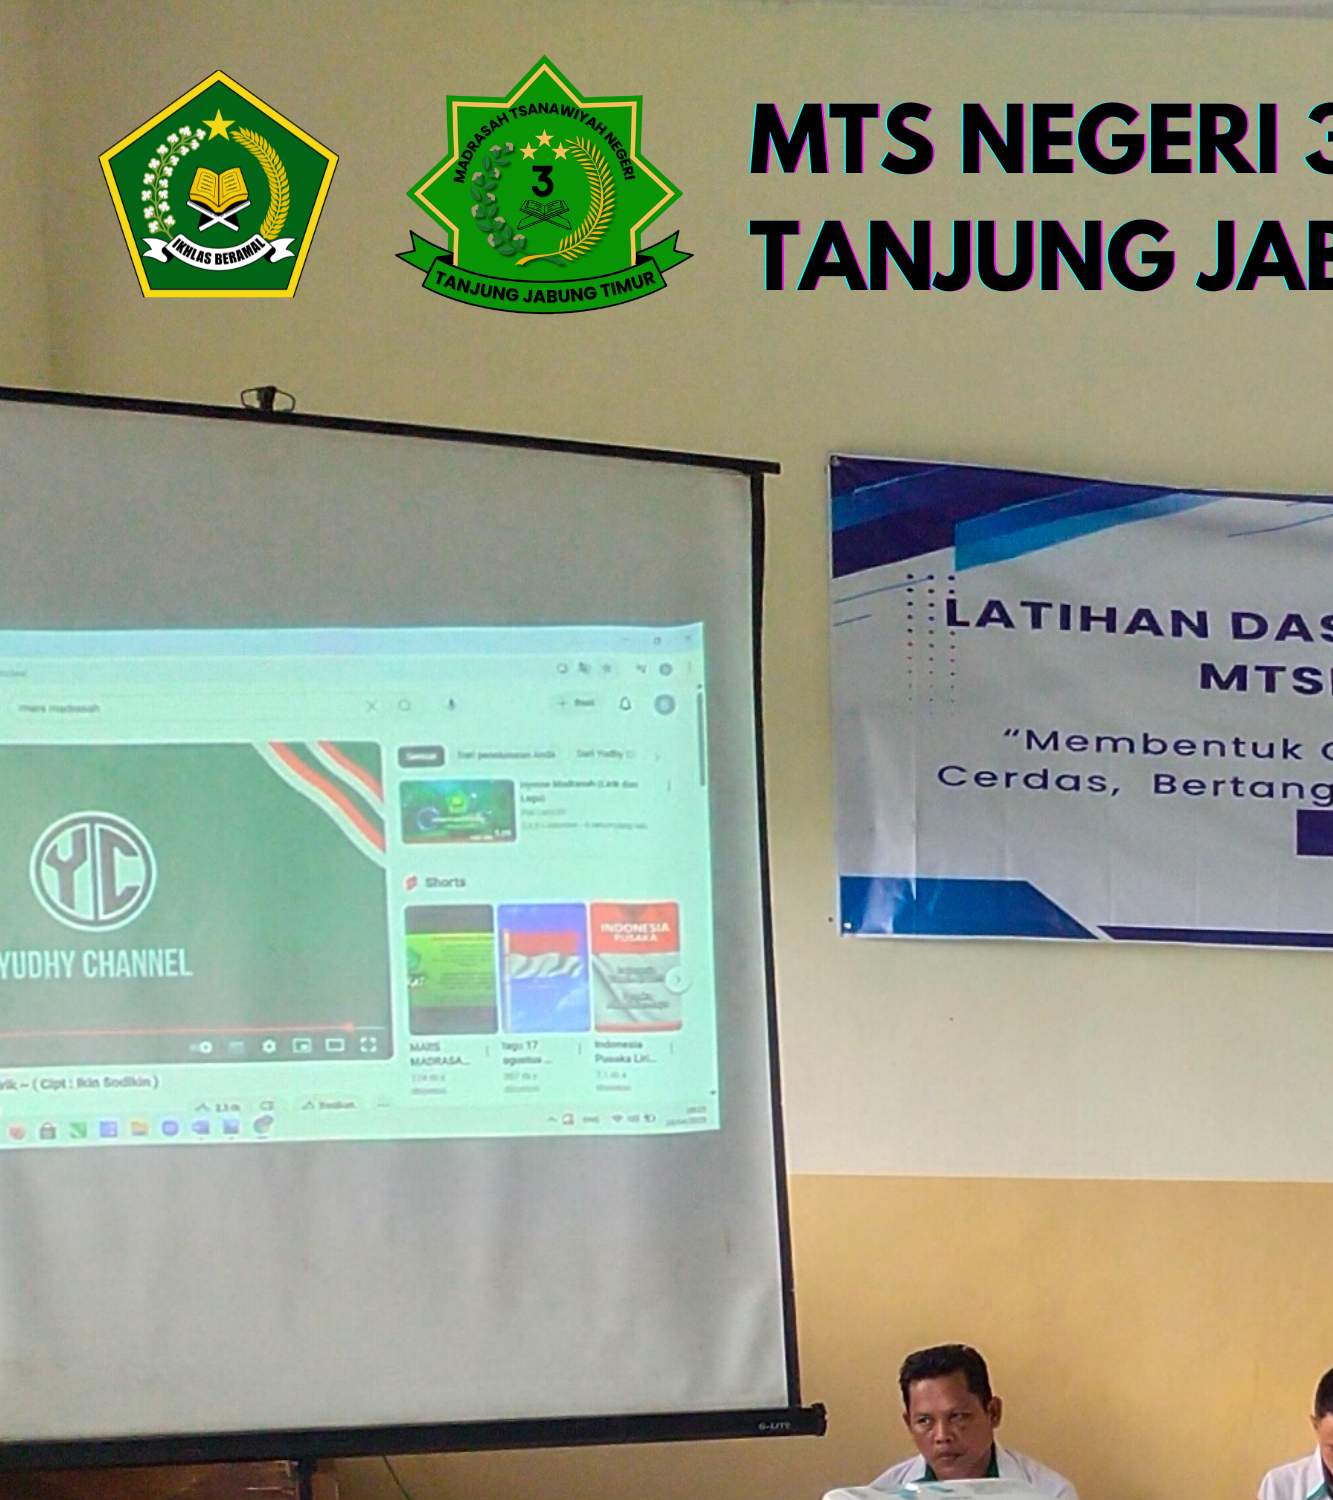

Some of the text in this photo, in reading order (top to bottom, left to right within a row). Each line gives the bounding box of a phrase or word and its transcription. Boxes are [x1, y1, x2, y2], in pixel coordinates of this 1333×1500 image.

[946, 598, 1209, 639] LATIHAN
[937, 765, 1123, 797] Cerdas,
[83, 948, 193, 979] CHANNEL
